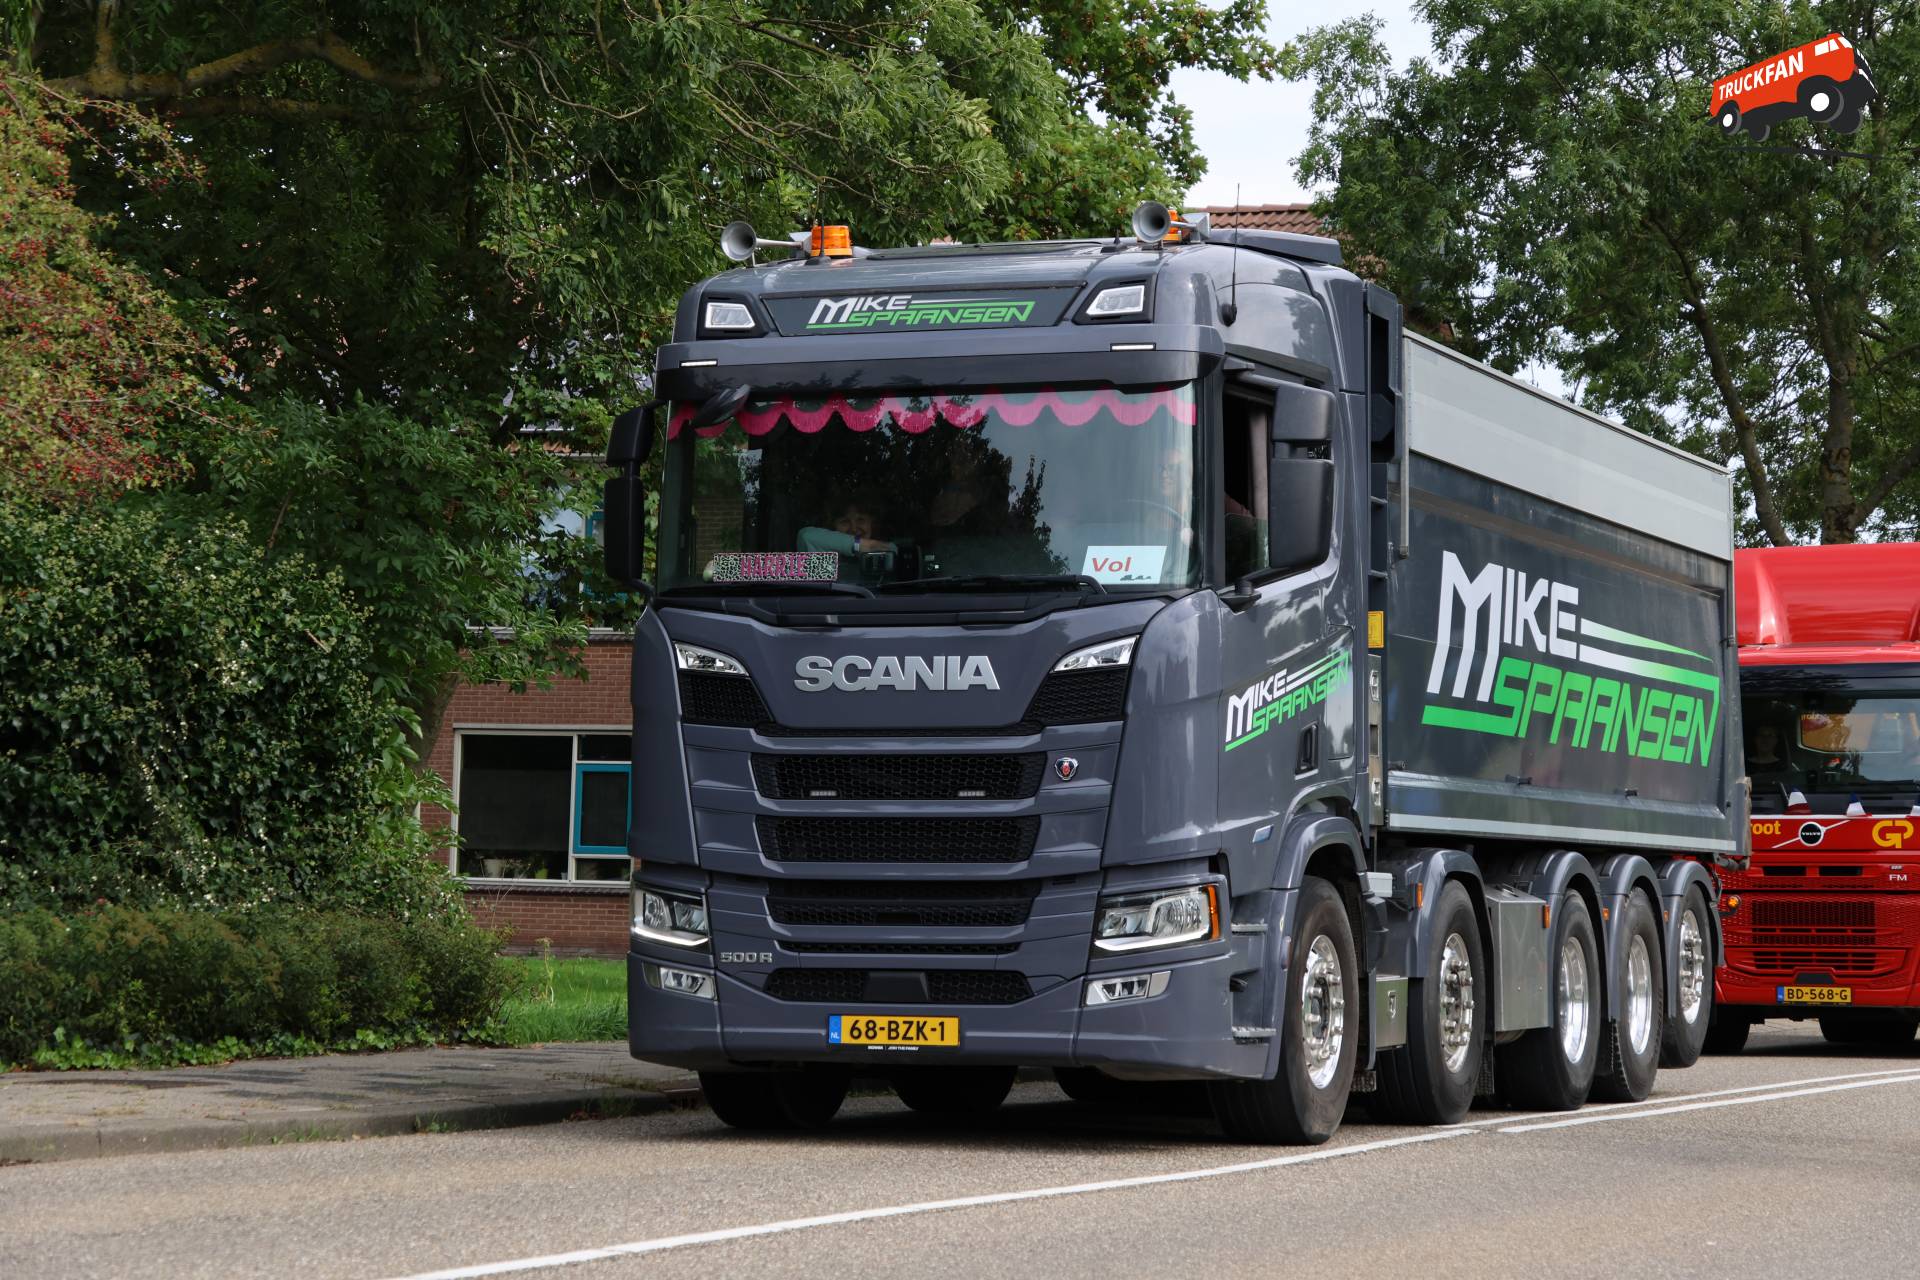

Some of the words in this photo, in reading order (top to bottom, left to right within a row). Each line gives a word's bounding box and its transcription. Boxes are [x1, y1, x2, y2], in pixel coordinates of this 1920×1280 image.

[808, 295, 912, 324] MIKE
[741, 555, 808, 577] HARRIE
[1092, 556, 1132, 573] Vol
[1426, 550, 1579, 702] MIKE
[794, 655, 1001, 692] SCANIA
[1225, 668, 1288, 742] MIKE
[720, 952, 757, 963] 500
[760, 952, 773, 963] R
[1787, 988, 1848, 1000] BD-568-G
[830, 1031, 840, 1040] NL
[850, 1020, 945, 1041] 68-BZK-1
